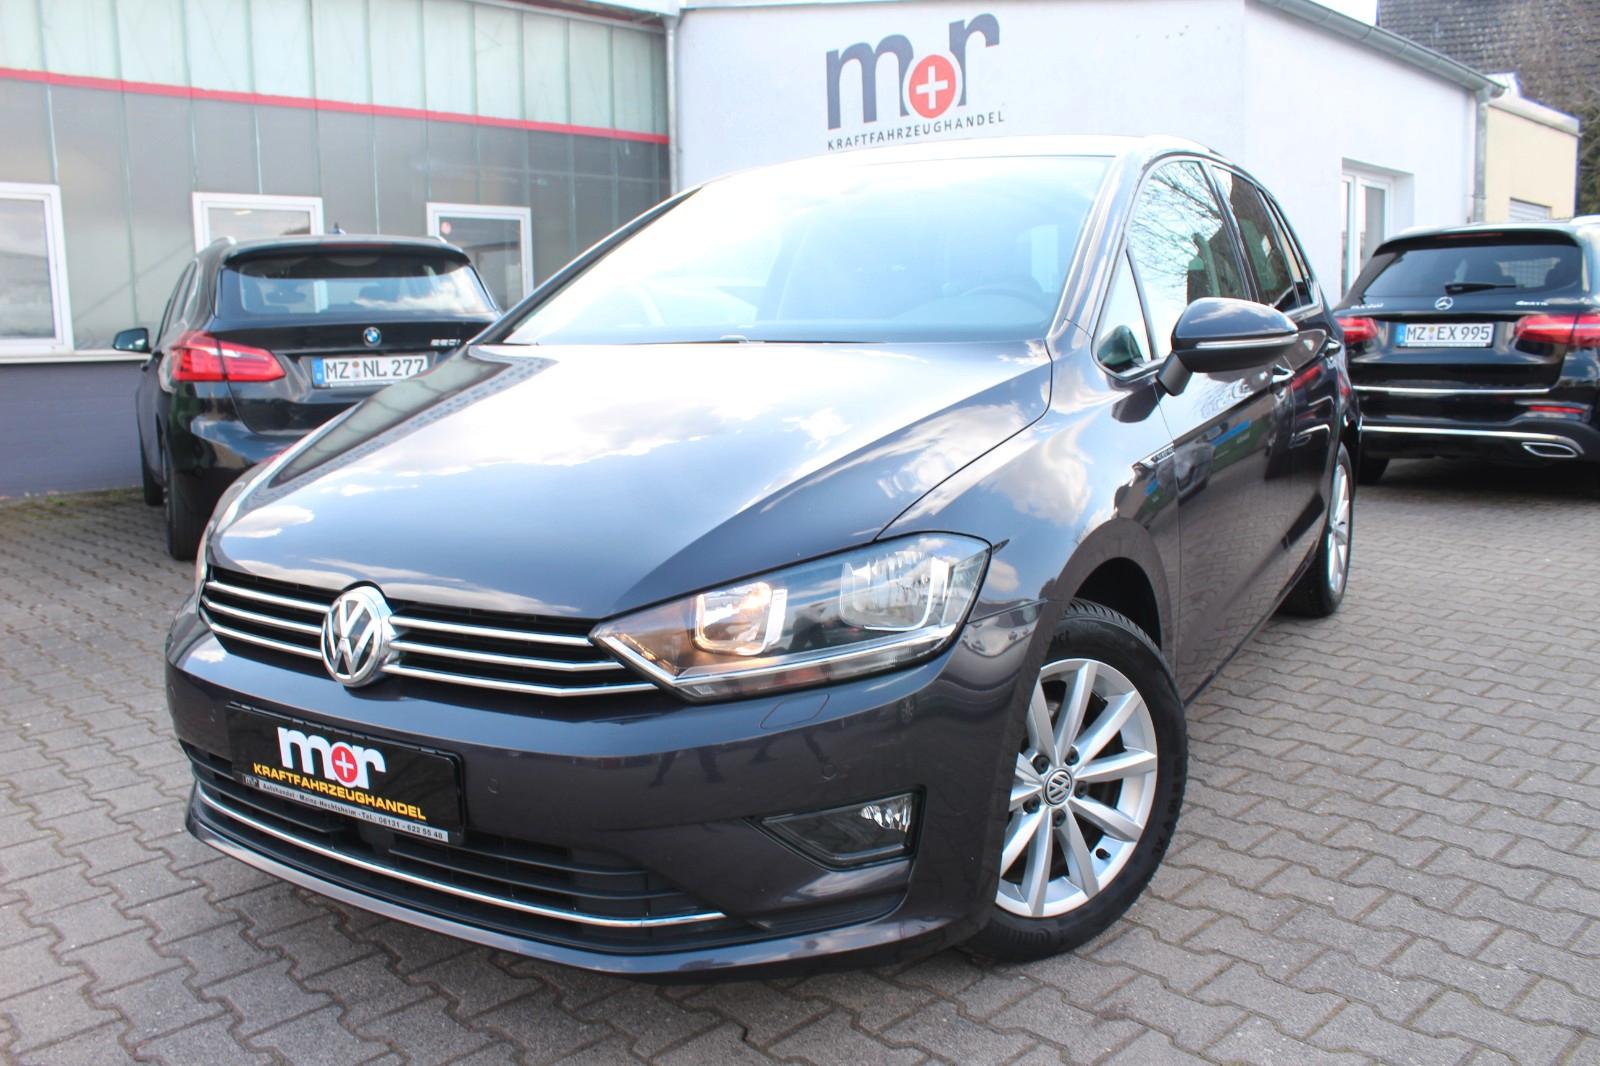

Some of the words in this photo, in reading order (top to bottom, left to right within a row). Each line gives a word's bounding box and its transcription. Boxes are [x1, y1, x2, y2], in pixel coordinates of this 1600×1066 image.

[827, 110, 1005, 151] KRAFTFAHRZEUGHANDEL
[1407, 326, 1426, 341] MZ
[1437, 326, 1457, 340] EX
[1461, 326, 1490, 340] 995
[325, 361, 350, 379] MZ
[363, 359, 388, 378] NL
[391, 358, 425, 377] 277
[253, 762, 427, 820] KRAFTFAHRZEUGHANDEL
